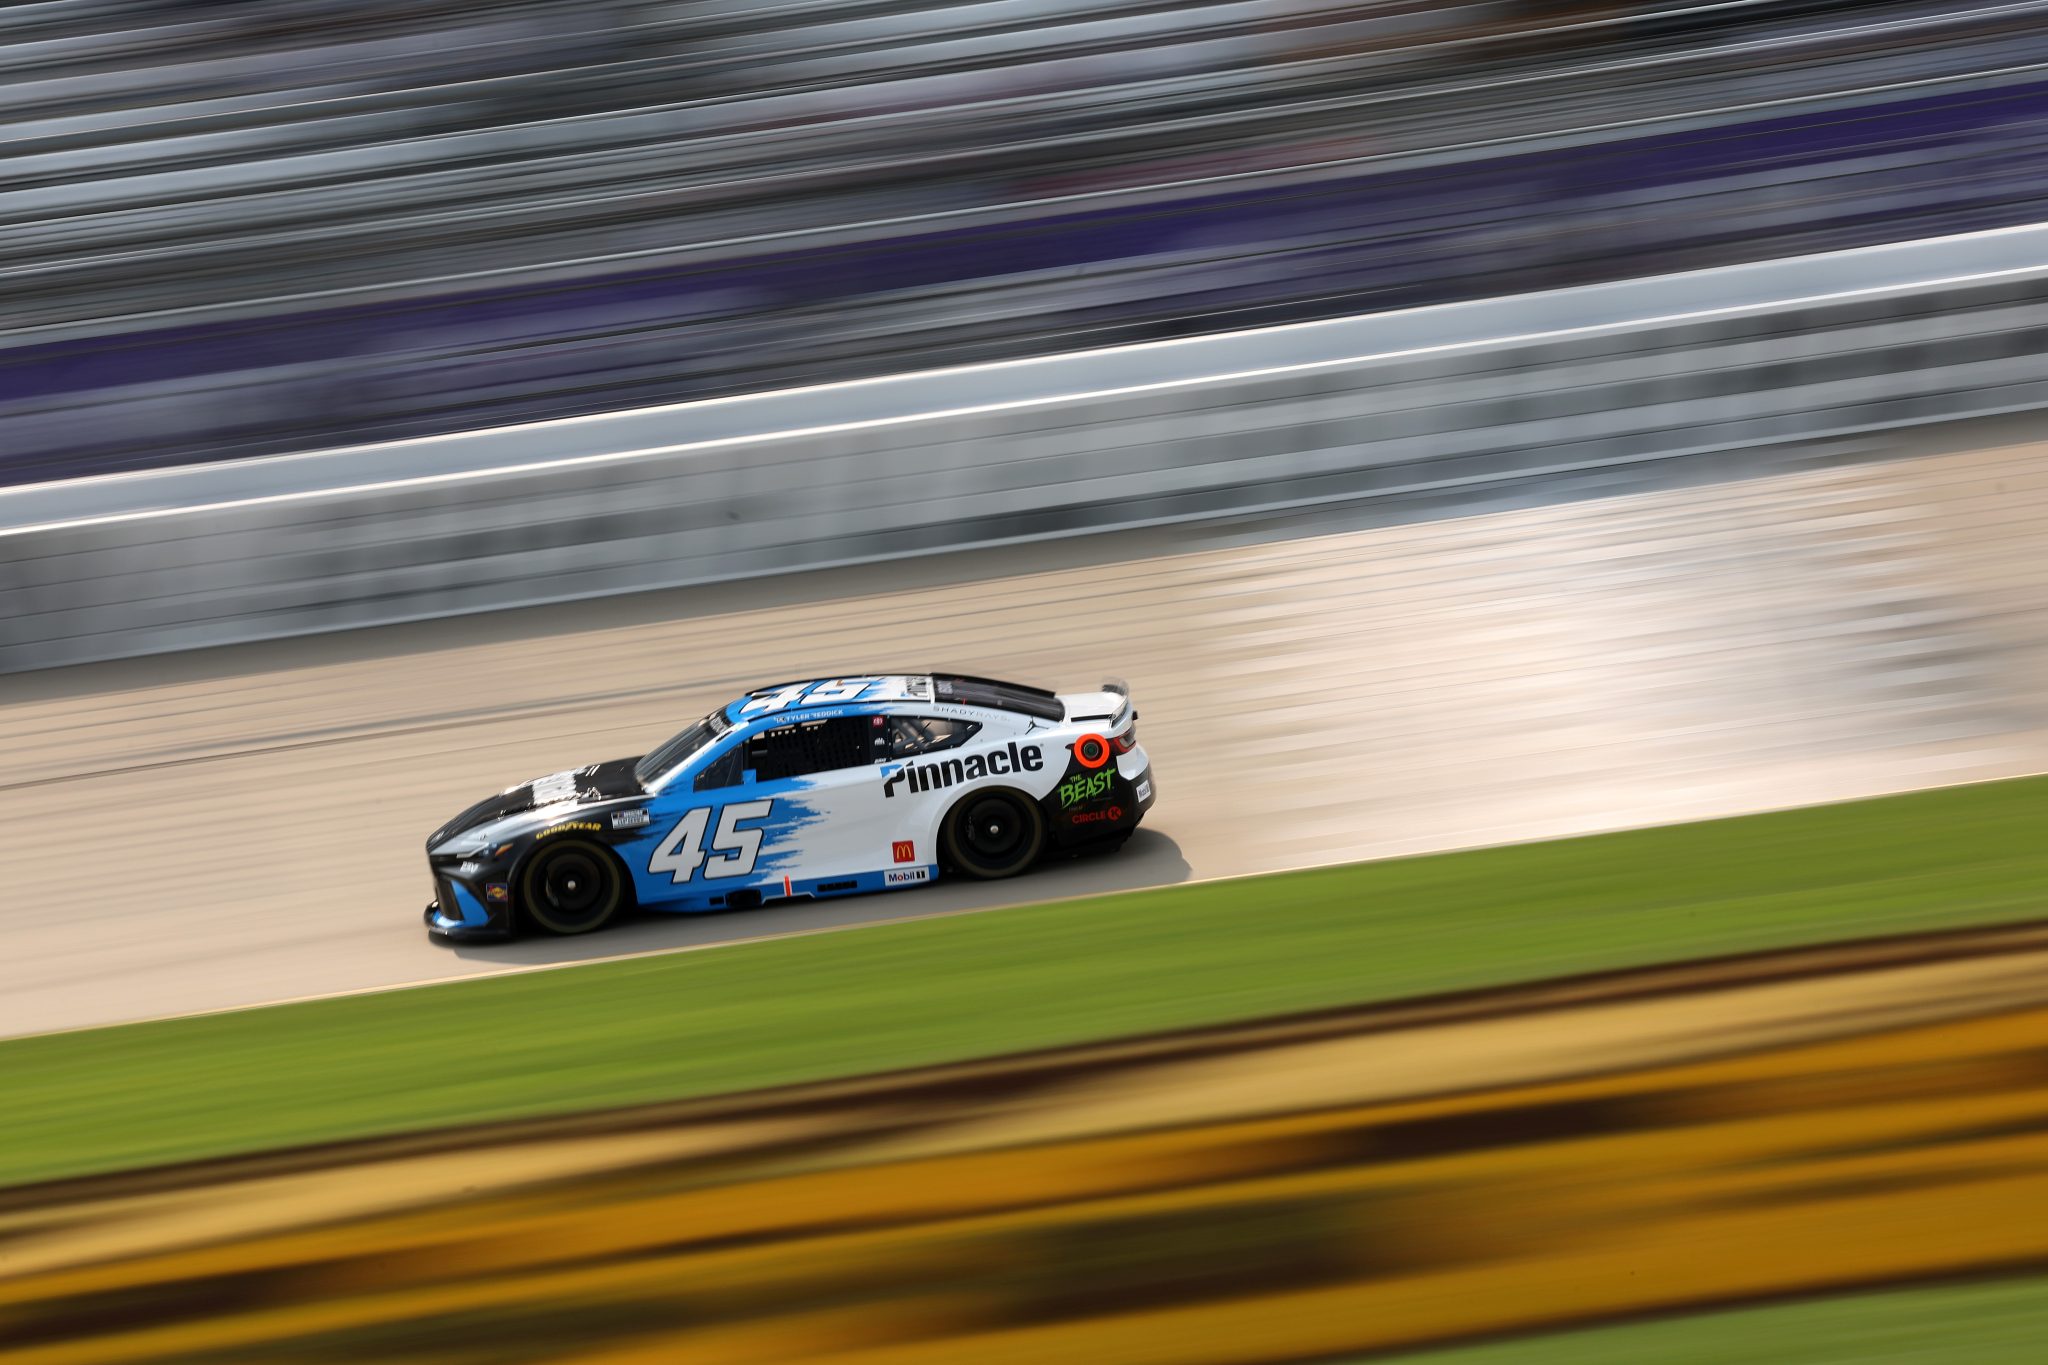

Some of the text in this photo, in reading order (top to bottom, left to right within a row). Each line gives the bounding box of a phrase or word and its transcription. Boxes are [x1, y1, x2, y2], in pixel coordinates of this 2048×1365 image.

[880, 741, 1043, 798] Pinnacle
[1058, 768, 1116, 808] BEAST
[535, 821, 602, 839] GOODYEAR
[1072, 811, 1106, 823] CIRCLE
[647, 799, 774, 884] 45
[888, 871, 915, 882] Mobil
